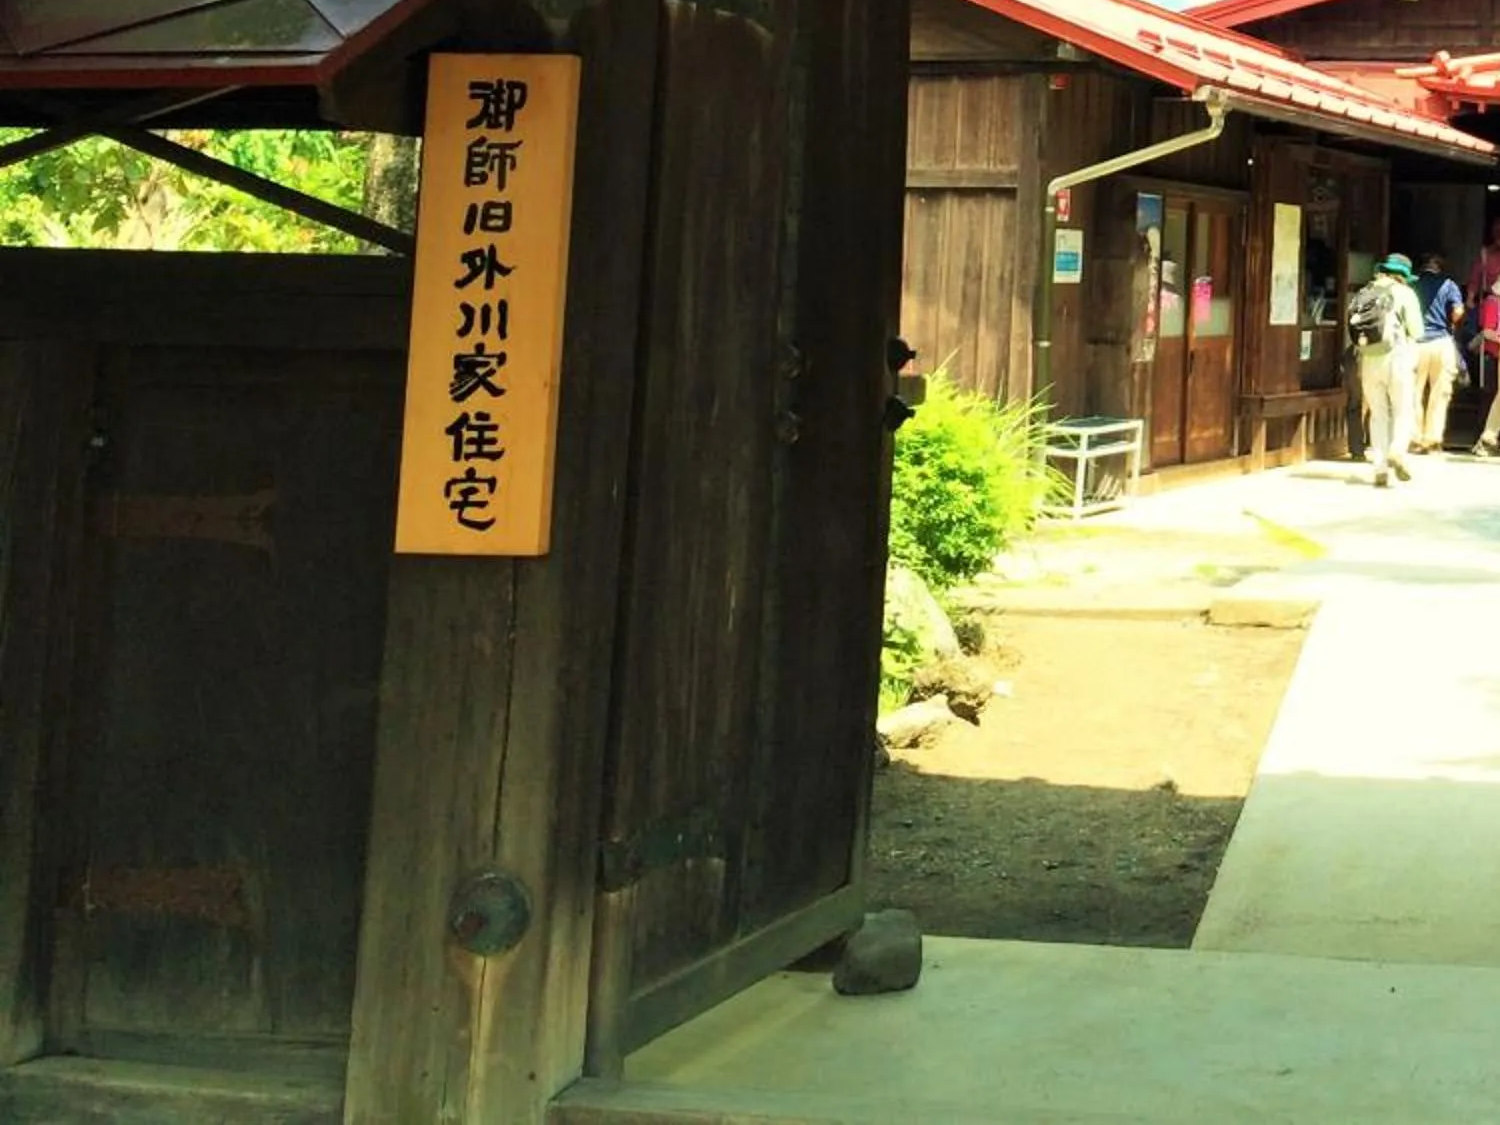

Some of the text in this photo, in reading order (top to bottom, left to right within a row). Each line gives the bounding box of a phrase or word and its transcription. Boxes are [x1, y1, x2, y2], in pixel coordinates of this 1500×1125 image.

[443, 80, 528, 532] 御師旧外川家住宅
